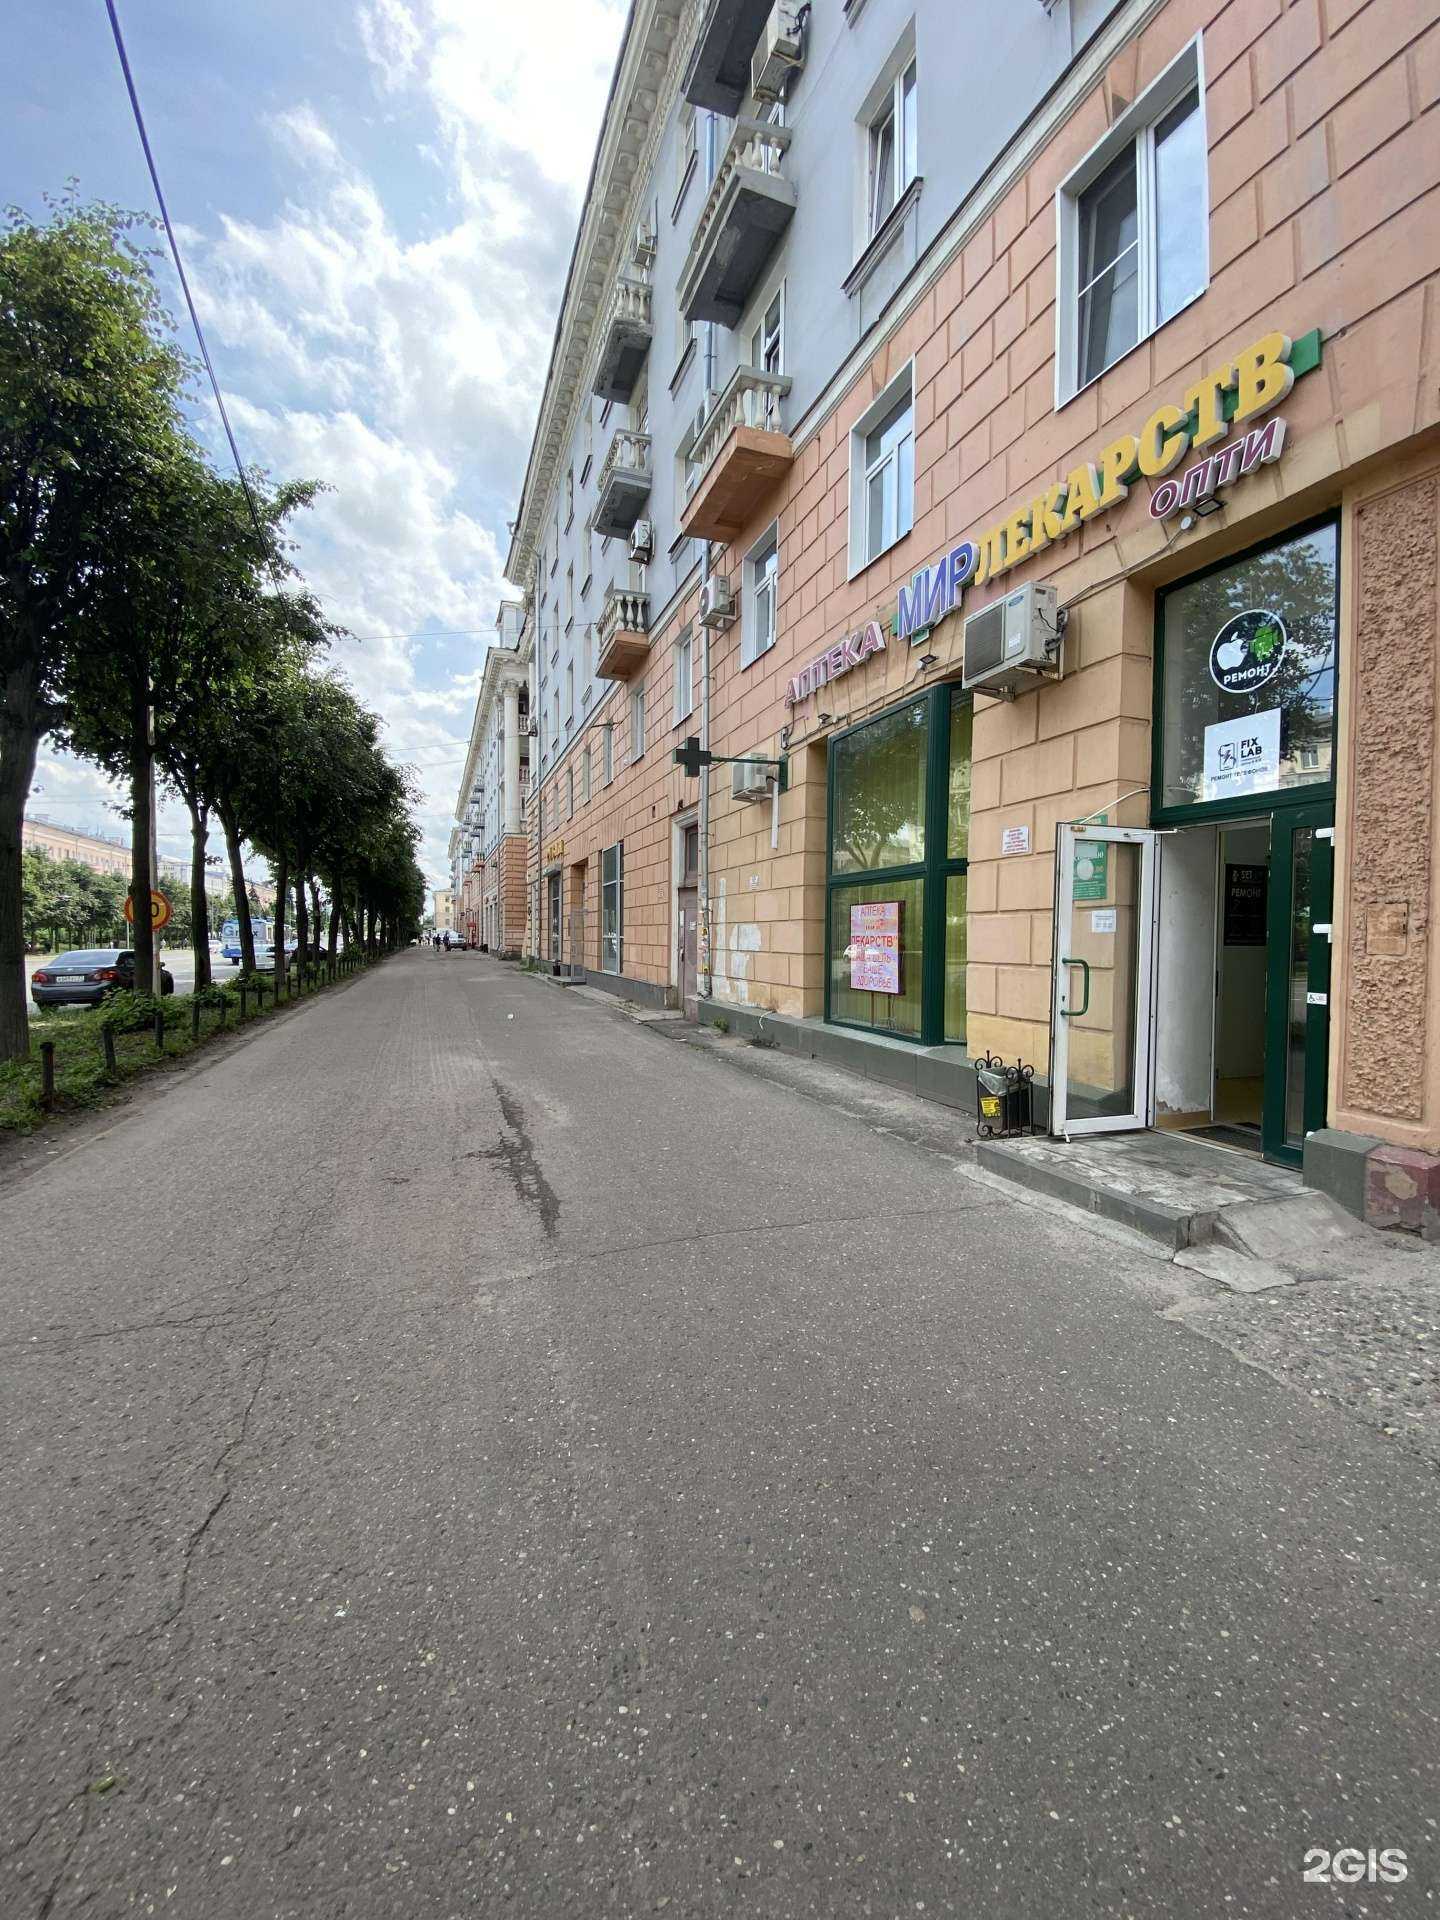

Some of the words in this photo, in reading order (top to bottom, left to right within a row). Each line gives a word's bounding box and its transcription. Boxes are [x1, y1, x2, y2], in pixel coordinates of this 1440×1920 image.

[1149, 416, 1288, 520] ОПТИ
[784, 620, 887, 710] АПТЕКА
[897, 541, 981, 641] МИР
[974, 330, 1295, 587] ЛЕКАРСТВ
[1223, 663, 1272, 685] РЕМОНТ
[1240, 737, 1259, 749] FIX
[1240, 746, 1262, 759] LAB
